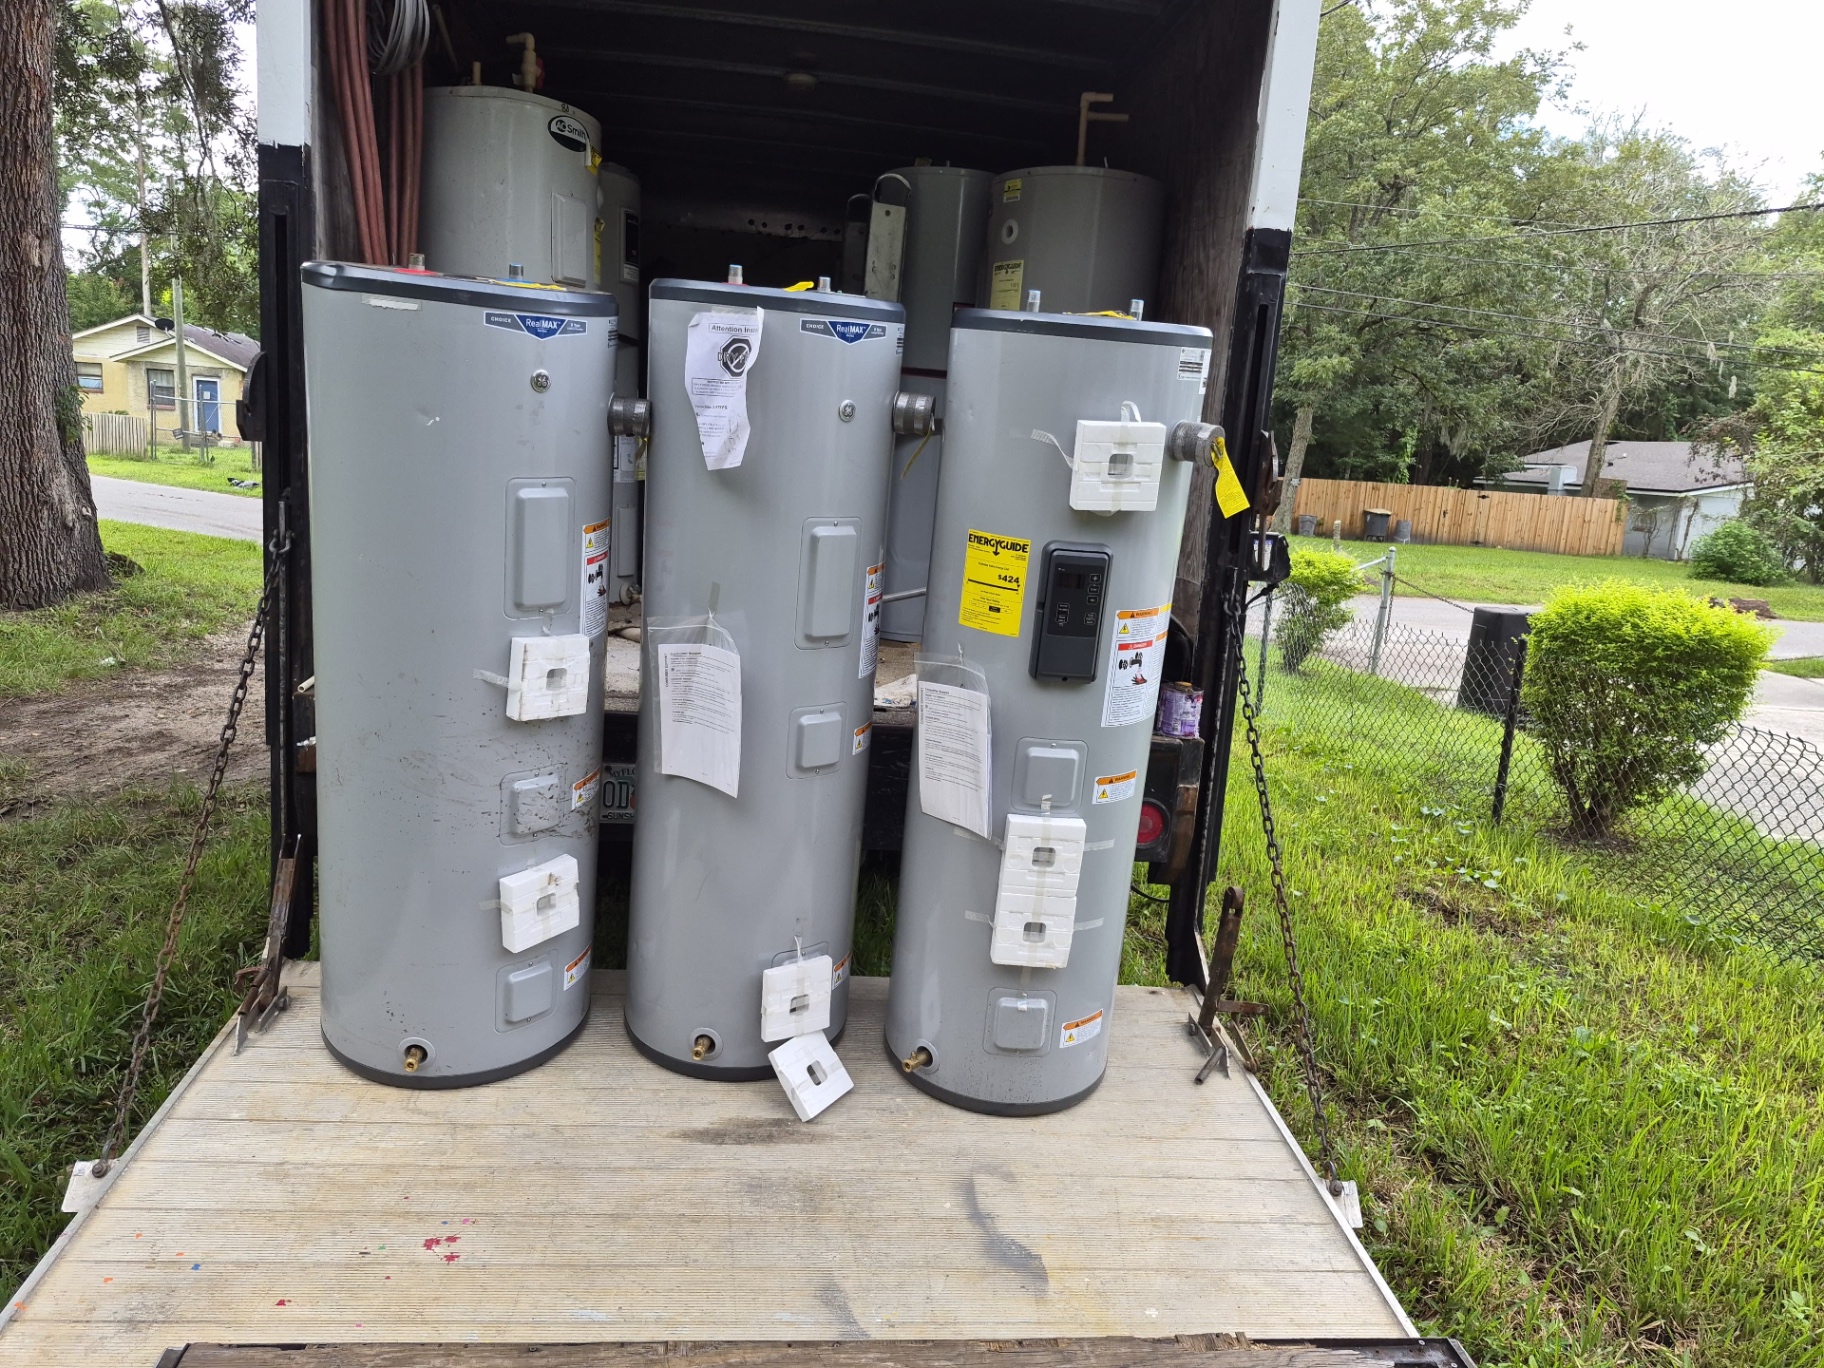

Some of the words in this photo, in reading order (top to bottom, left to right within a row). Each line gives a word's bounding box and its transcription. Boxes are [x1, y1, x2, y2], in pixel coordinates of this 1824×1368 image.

[490, 315, 512, 323] CHOICE
[710, 324, 743, 333] Attention
[968, 533, 1030, 554] ENERGYGUIDE
[997, 574, 1020, 584] $424
